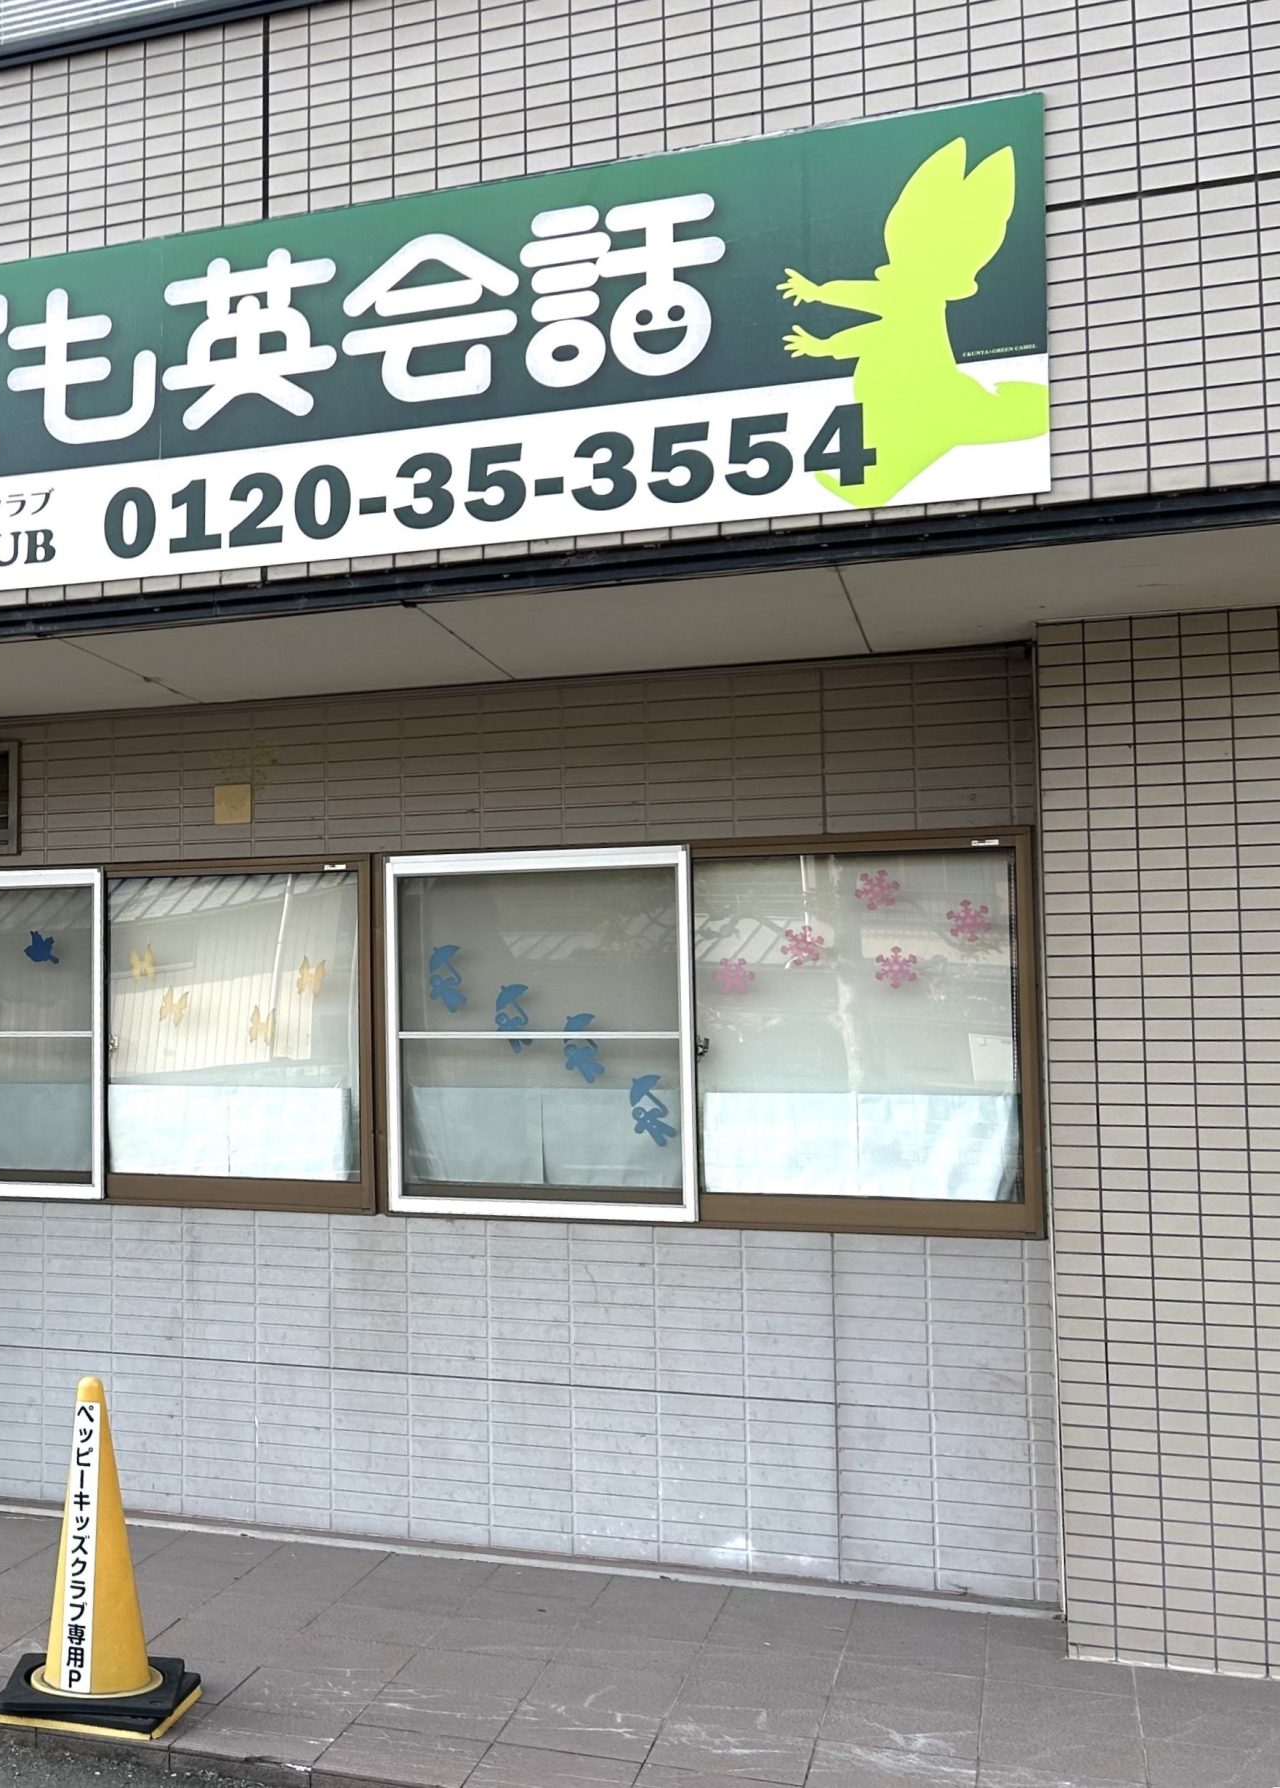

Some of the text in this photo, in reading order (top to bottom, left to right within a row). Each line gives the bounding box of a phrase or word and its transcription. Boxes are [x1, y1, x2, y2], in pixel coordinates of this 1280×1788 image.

[103, 403, 878, 559] 0120-35-3554
[66, 1404, 95, 1690] ペッピーキッズクラブ専用P
